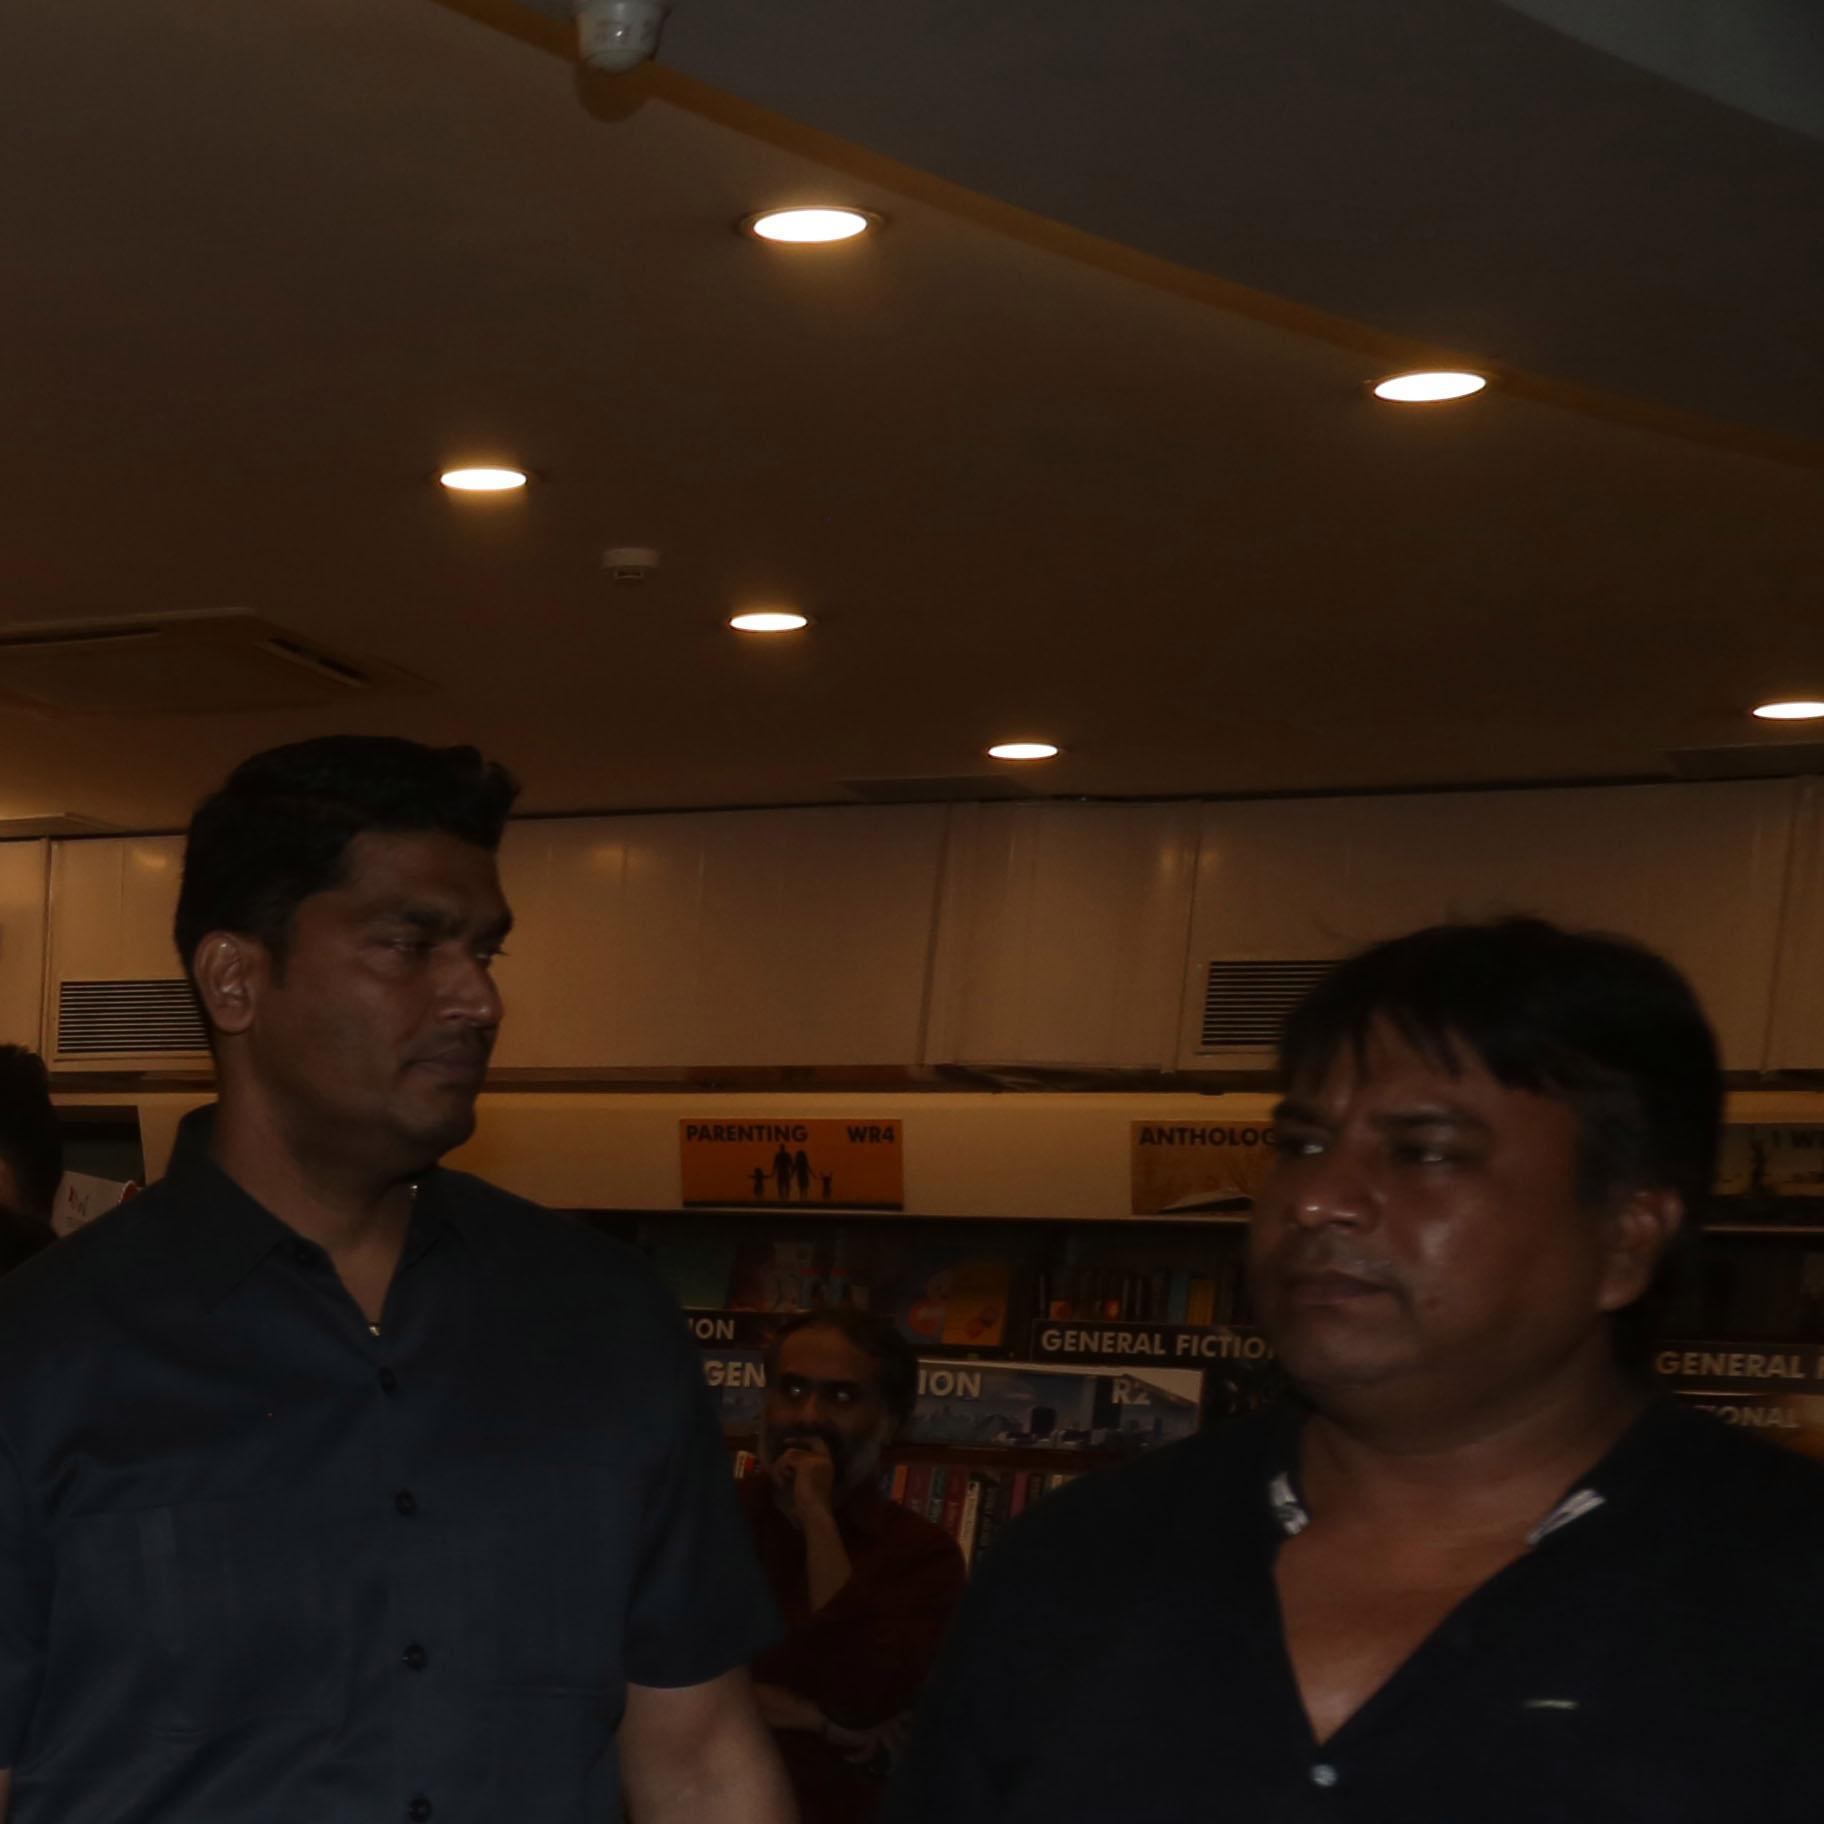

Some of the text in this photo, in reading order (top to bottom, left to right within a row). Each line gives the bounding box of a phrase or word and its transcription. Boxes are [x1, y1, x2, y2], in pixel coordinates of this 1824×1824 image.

[686, 1124, 809, 1143] PARENTING
[847, 1126, 895, 1145] WR4
[1041, 1328, 1167, 1356] GENERAL
[1656, 1352, 1805, 1379] GENERAL
